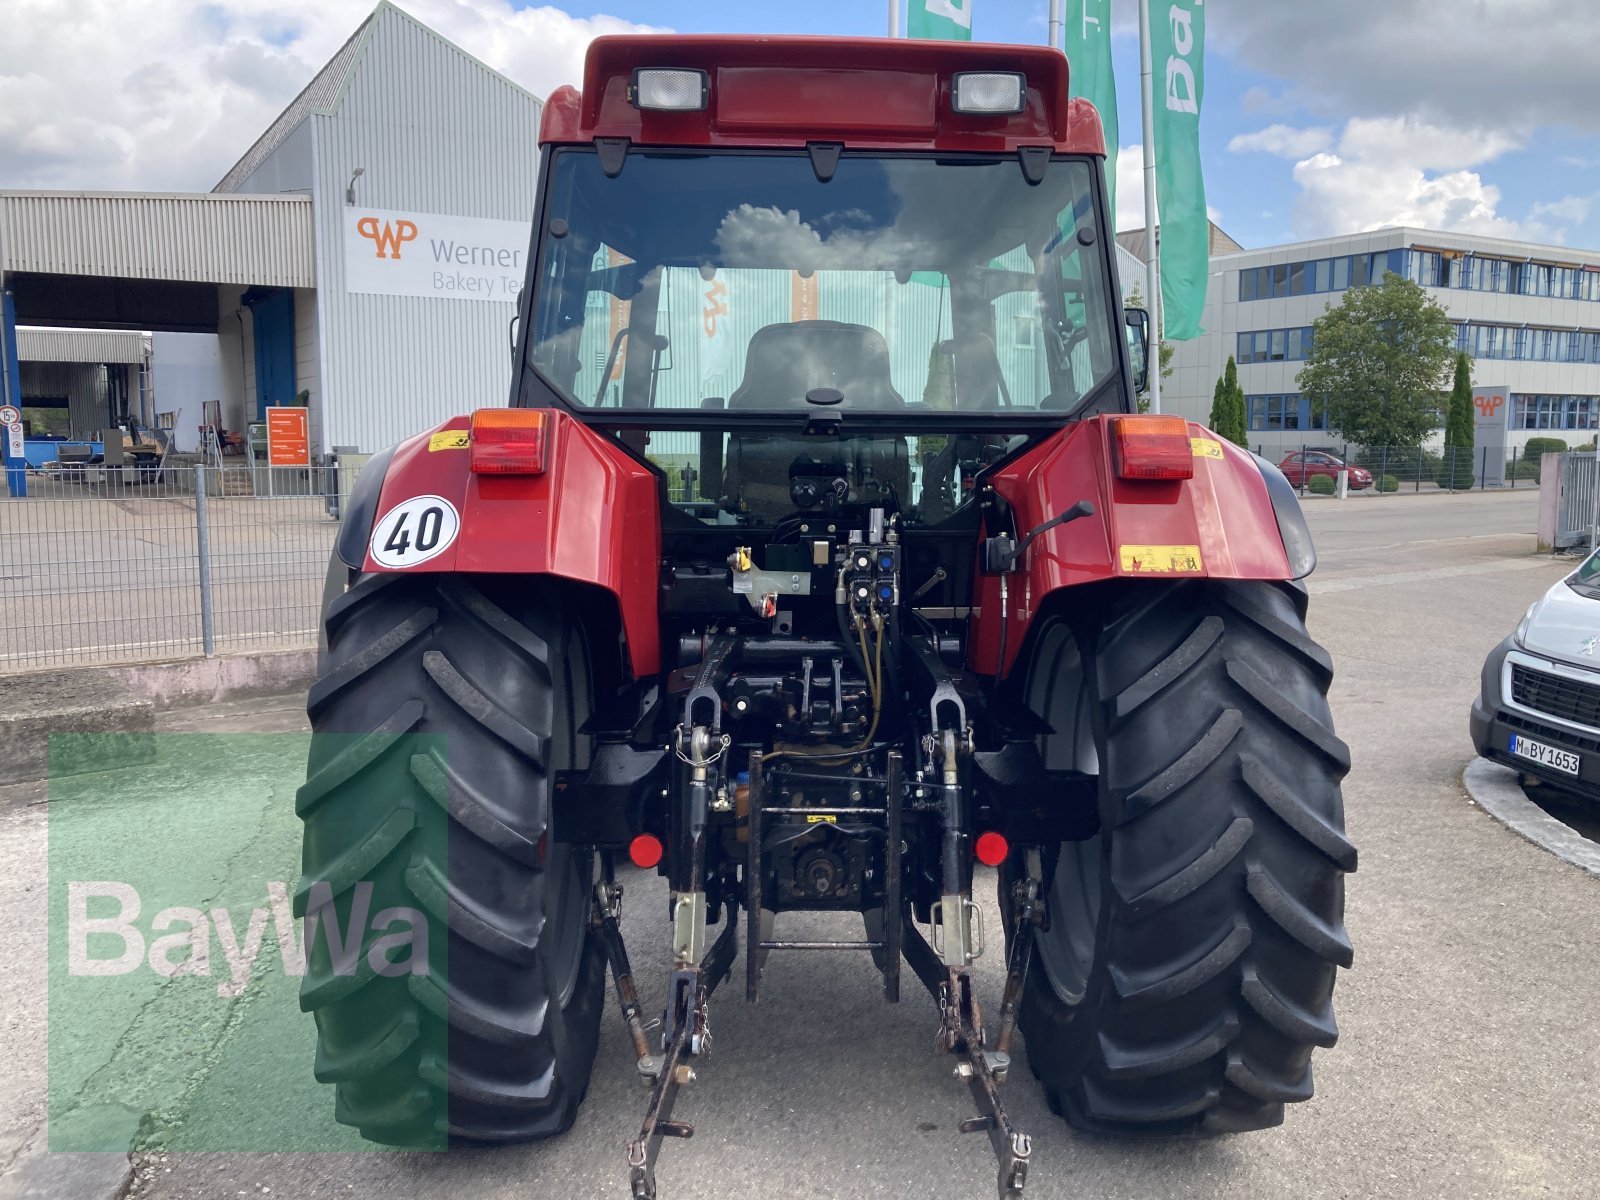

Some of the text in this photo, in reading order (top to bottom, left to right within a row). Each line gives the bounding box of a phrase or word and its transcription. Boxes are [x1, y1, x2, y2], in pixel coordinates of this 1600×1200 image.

[430, 239, 521, 268] Werner
[433, 271, 495, 297] Bakery
[3, 410, 10, 421] 15
[383, 506, 443, 556] 40
[1516, 738, 1578, 772] M BY 1653
